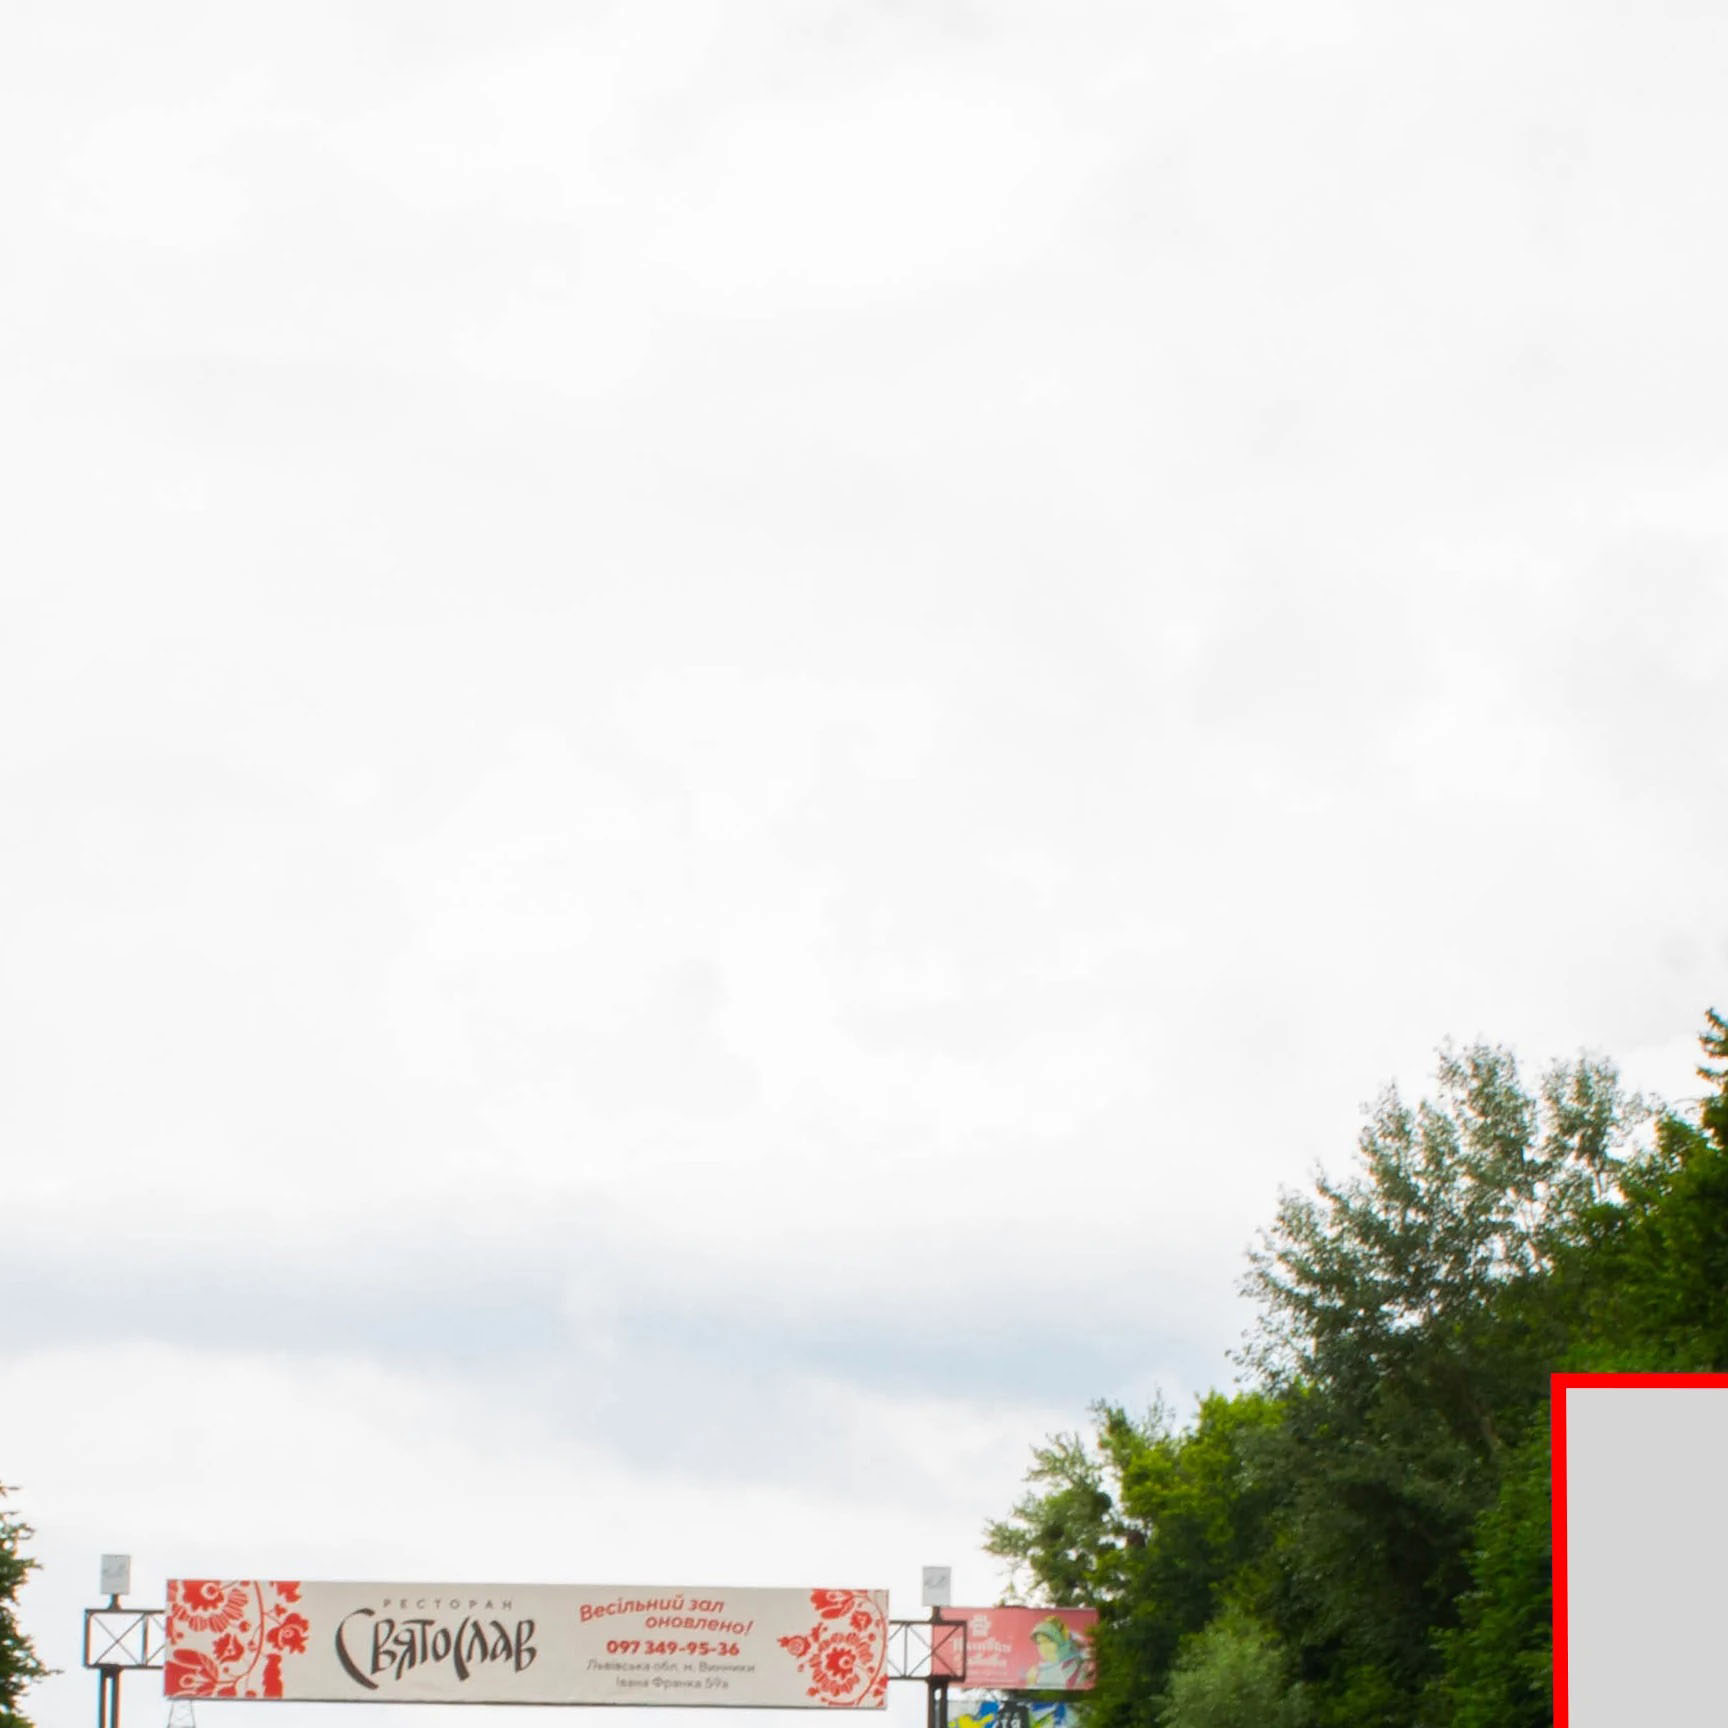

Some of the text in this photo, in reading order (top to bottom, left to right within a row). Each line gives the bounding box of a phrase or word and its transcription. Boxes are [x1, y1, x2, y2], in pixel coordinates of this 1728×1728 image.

[382, 1598, 513, 1610] РЕСТОРАН
[579, 1593, 725, 1622] Весільний зал
[645, 1615, 754, 1636] оновлено!
[606, 1639, 740, 1656] 097 349-95-36
[652, 1676, 704, 1690] Франка
